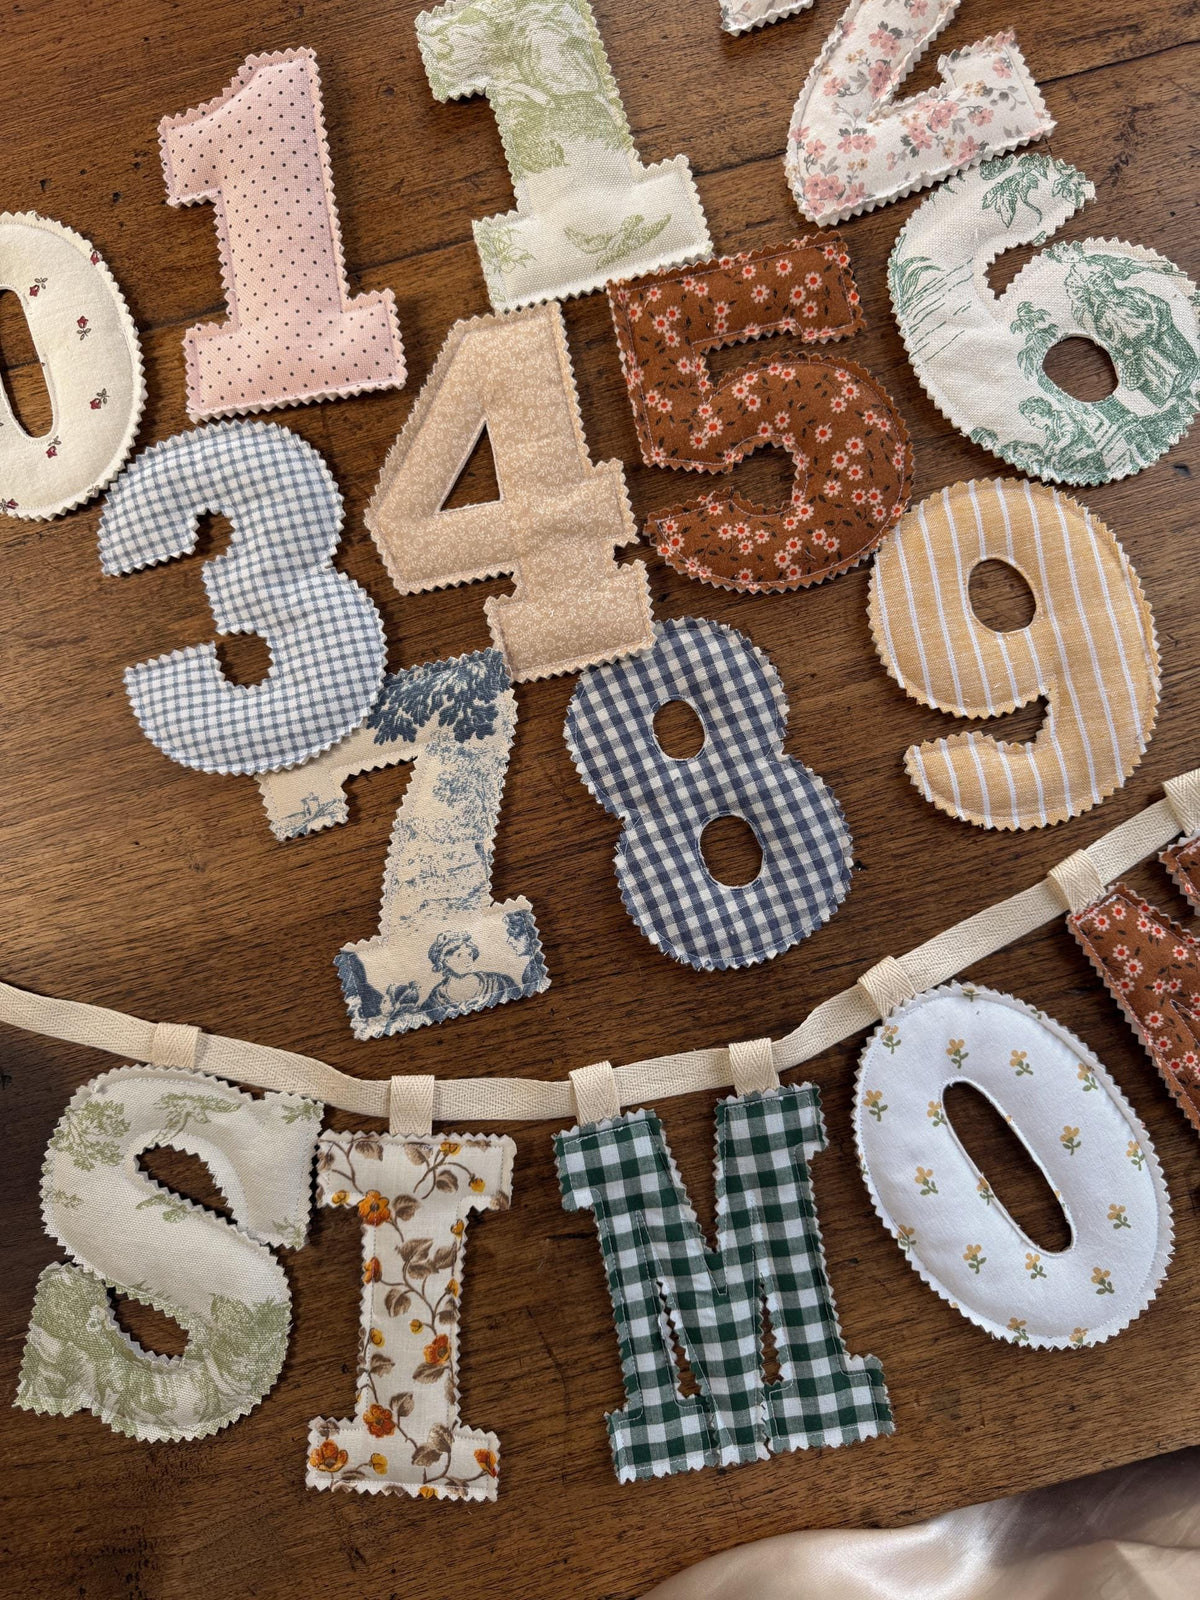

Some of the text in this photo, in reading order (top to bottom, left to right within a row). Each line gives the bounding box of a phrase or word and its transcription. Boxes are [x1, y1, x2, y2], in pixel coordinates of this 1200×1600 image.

[157, 46, 407, 423] 1
[414, 0, 712, 311] 1
[887, 153, 1200, 486] 6
[364, 298, 656, 683] 4
[606, 231, 913, 593] 5
[97, 419, 389, 776] 3
[867, 477, 1162, 831] 9
[254, 648, 552, 1040] 7
[563, 617, 853, 971] 8
